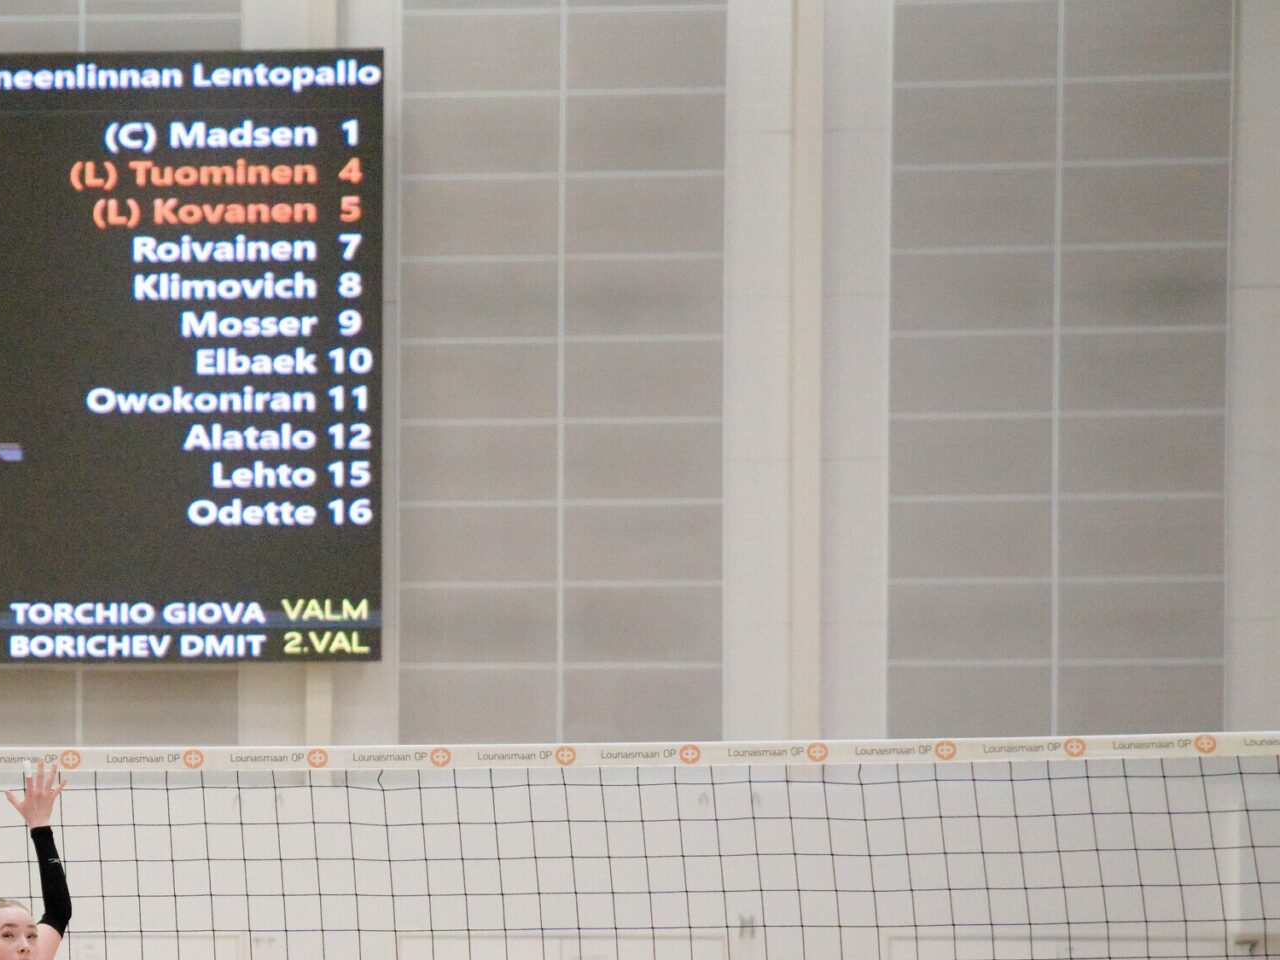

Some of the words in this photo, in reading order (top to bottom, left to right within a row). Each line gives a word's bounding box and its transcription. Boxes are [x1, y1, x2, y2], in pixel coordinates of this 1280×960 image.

[192, 59, 381, 92] Lentopallo
[104, 122, 157, 153] (C)
[168, 119, 317, 149] Madsen
[341, 119, 358, 146] 1
[70, 161, 118, 191] (L)
[128, 158, 317, 187] Tuominen
[339, 158, 362, 184] 4
[93, 198, 140, 229] (L)
[154, 198, 317, 225] Kovanen
[340, 196, 361, 222] 5
[131, 234, 317, 263] Roivainen
[338, 233, 362, 260] 7
[132, 271, 317, 300] Klimovich
[337, 271, 362, 298] 8
[180, 310, 318, 338] Mosser
[337, 309, 362, 336] 9
[195, 347, 317, 376] Elbaek
[328, 347, 373, 374] 10
[85, 385, 316, 414] Owokoniran
[328, 385, 367, 412] 11
[182, 422, 316, 451] Alatalo
[327, 423, 371, 450] 12
[211, 460, 316, 488] Lehto
[327, 460, 371, 488] 15
[186, 498, 316, 526] Odette
[327, 498, 372, 525] 16
[10, 603, 155, 625] TORCHIO
[162, 602, 266, 625] GIOVA
[282, 599, 368, 620] VALM
[9, 634, 172, 658] BORICHEV
[180, 634, 267, 657] DMIT
[284, 631, 370, 653] 2.VAL
[230, 753, 288, 762] Lounaismaan
[291, 753, 304, 762] OP
[353, 752, 411, 762] Lounaismaan
[414, 752, 427, 762] OP
[477, 751, 536, 761] Lounaismaan
[539, 751, 552, 760] OP
[601, 750, 660, 760] Lounaismaan
[663, 749, 676, 759] OP
[728, 748, 786, 757] Lounaismaan
[790, 747, 804, 756] OP
[855, 746, 915, 756] Lounaismaan
[918, 745, 931, 754] OP
[983, 744, 1044, 753] Lounaismaan
[1047, 743, 1060, 752] OP
[1113, 741, 1174, 750] Lounaismaan
[1178, 739, 1190, 748] OP
[107, 754, 165, 764] Lounaismaan
[167, 754, 180, 763] OP
